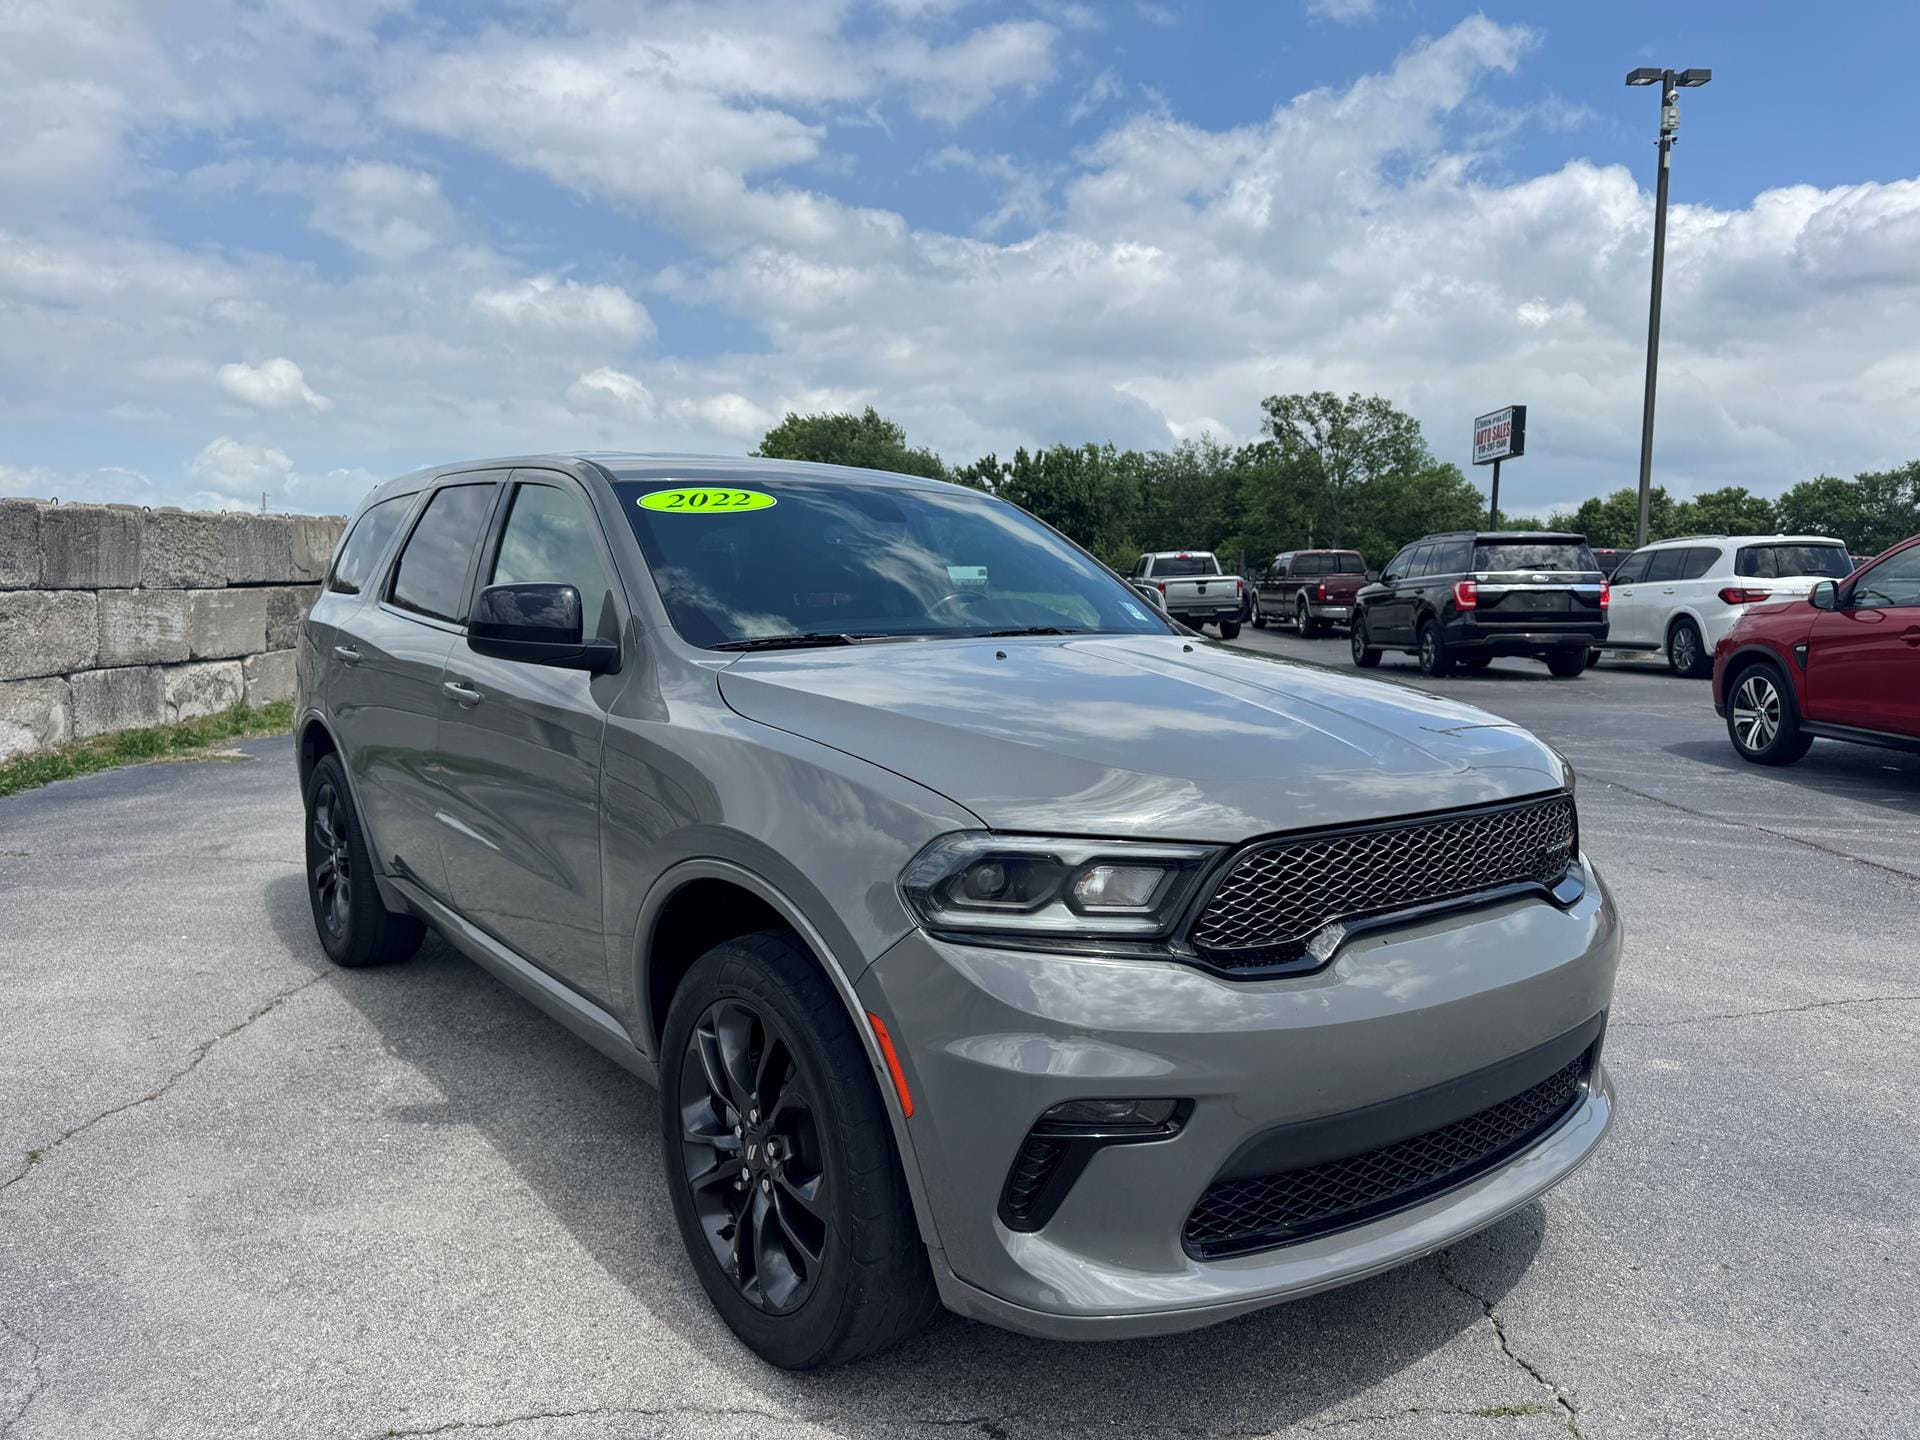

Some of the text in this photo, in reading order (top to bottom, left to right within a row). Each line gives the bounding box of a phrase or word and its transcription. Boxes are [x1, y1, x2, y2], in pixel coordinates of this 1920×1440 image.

[1476, 421, 1510, 446] AUTO SALES
[666, 492, 751, 508] 2022
